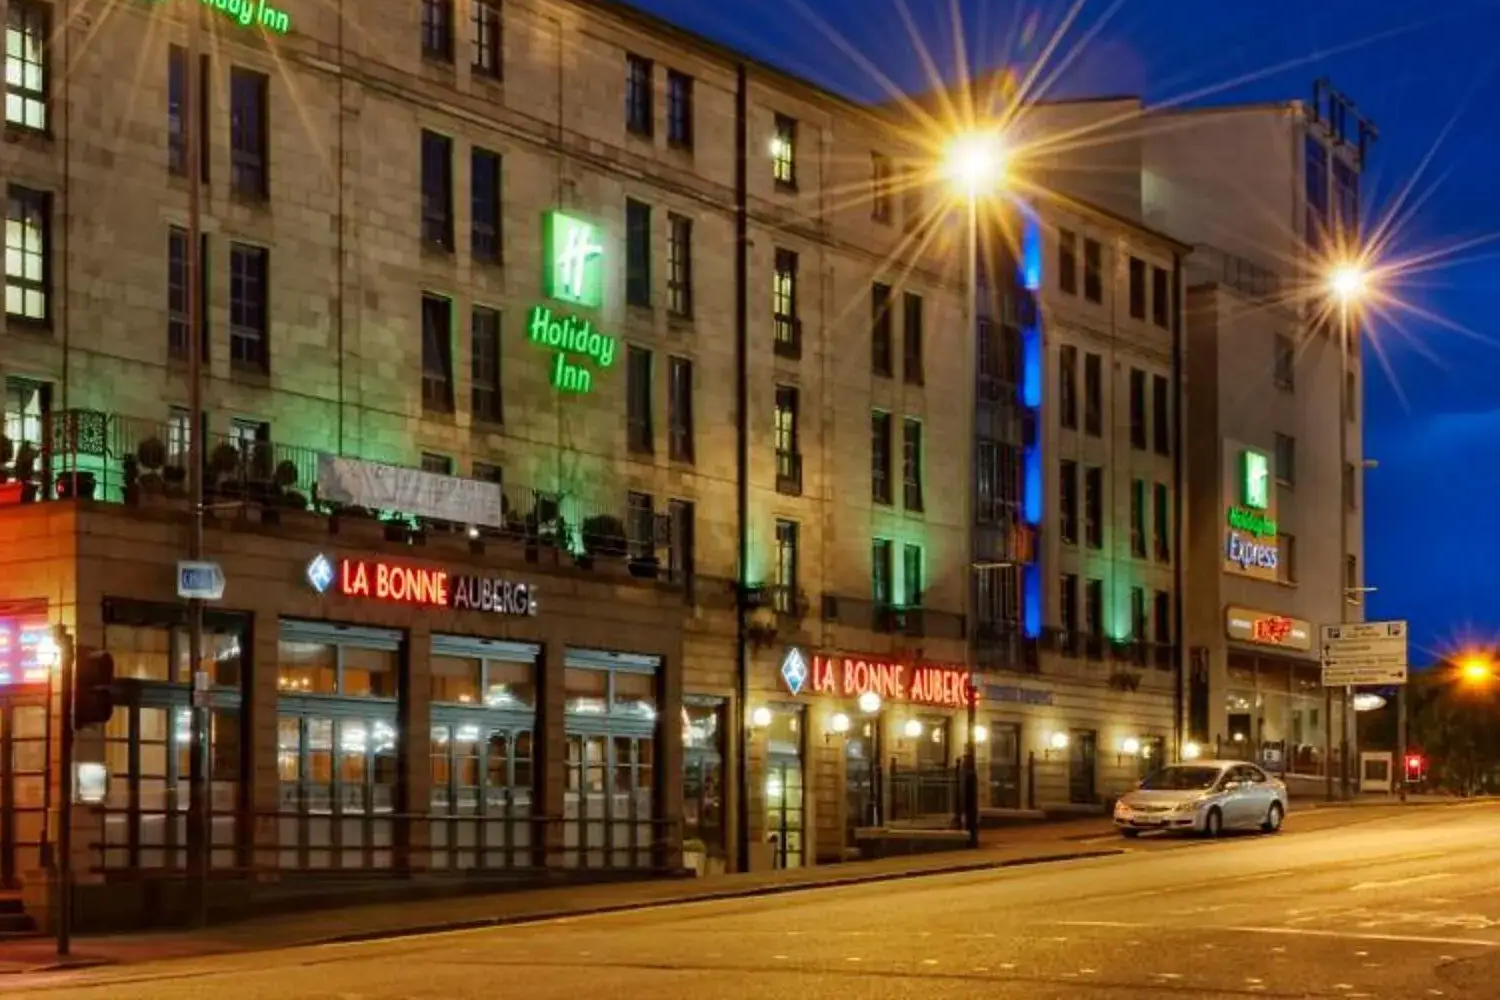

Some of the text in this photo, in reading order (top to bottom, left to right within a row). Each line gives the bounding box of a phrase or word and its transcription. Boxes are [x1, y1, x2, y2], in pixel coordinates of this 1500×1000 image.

[531, 306, 615, 367] Holiday
[555, 352, 591, 392] Inn
[1229, 532, 1278, 570] Express
[342, 559, 539, 616] LA BONNE AUBERGE
[813, 656, 836, 693] LA
[844, 659, 904, 699] BONNE
